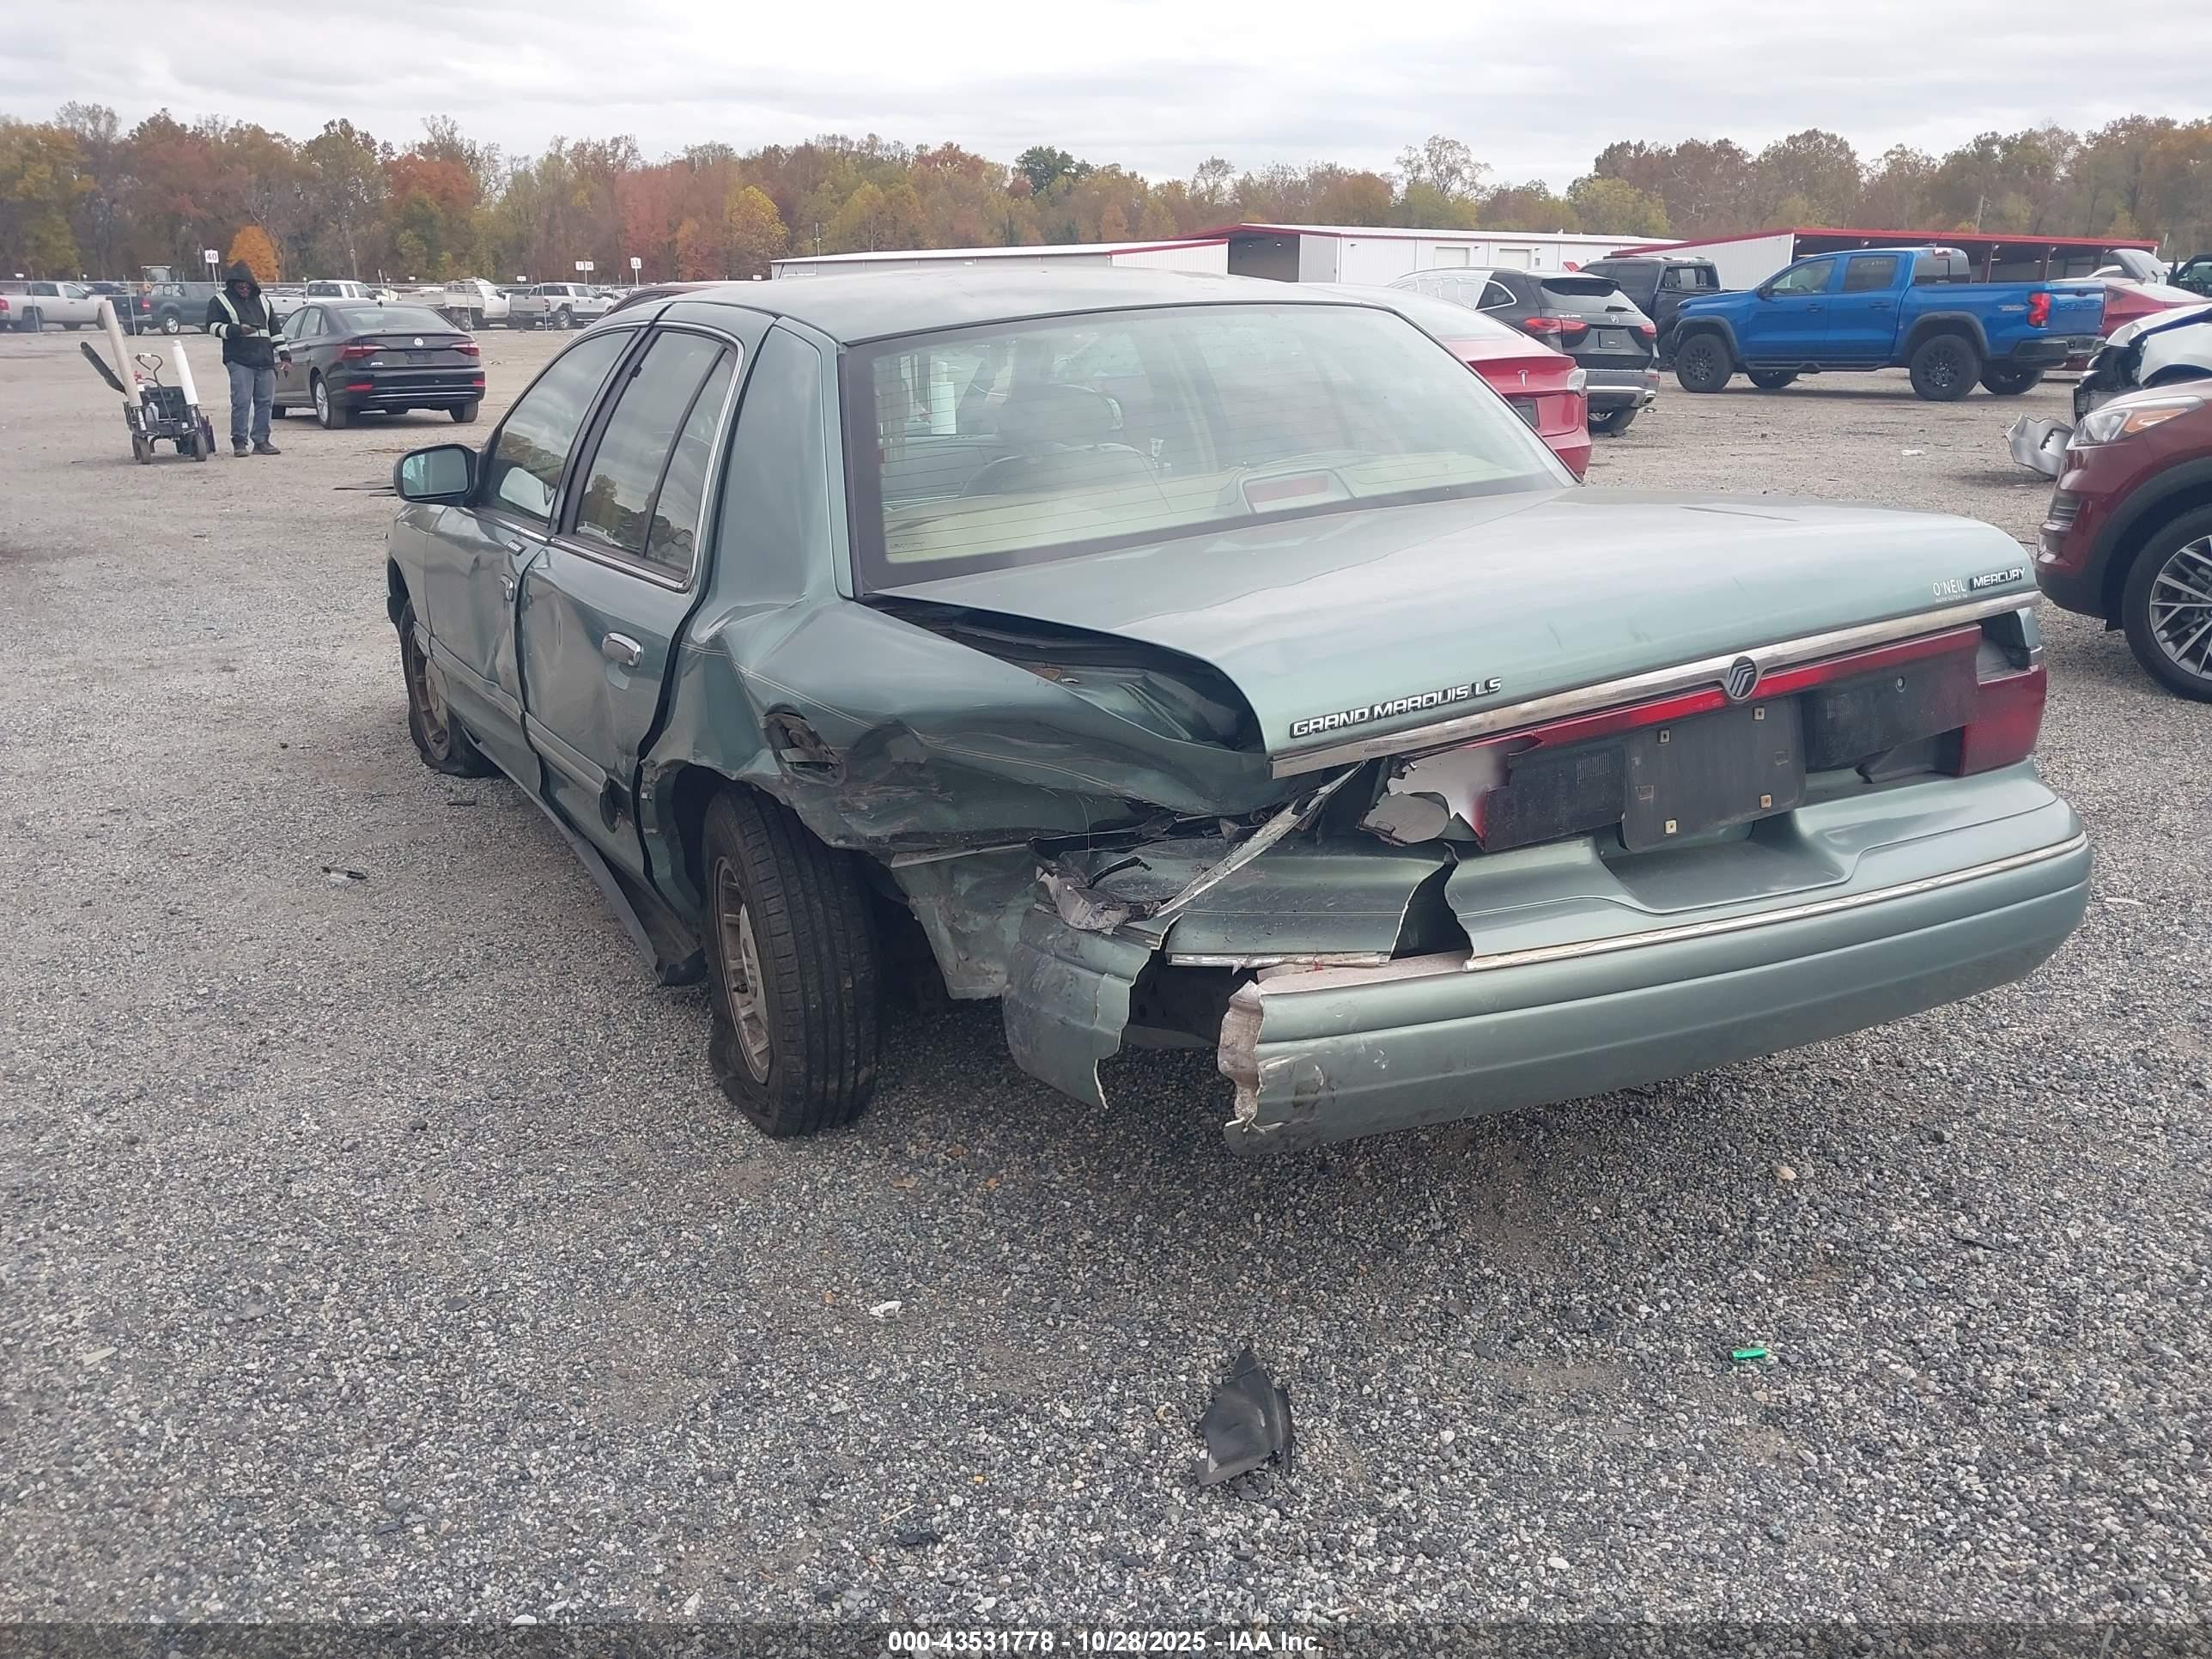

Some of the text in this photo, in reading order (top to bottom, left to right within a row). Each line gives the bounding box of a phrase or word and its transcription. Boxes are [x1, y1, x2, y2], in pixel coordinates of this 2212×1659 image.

[1933, 579, 1966, 596] O'NEIL
[1973, 567, 2026, 589] MERCURY
[1291, 677, 1502, 737] GRAND MARQUIS LS
